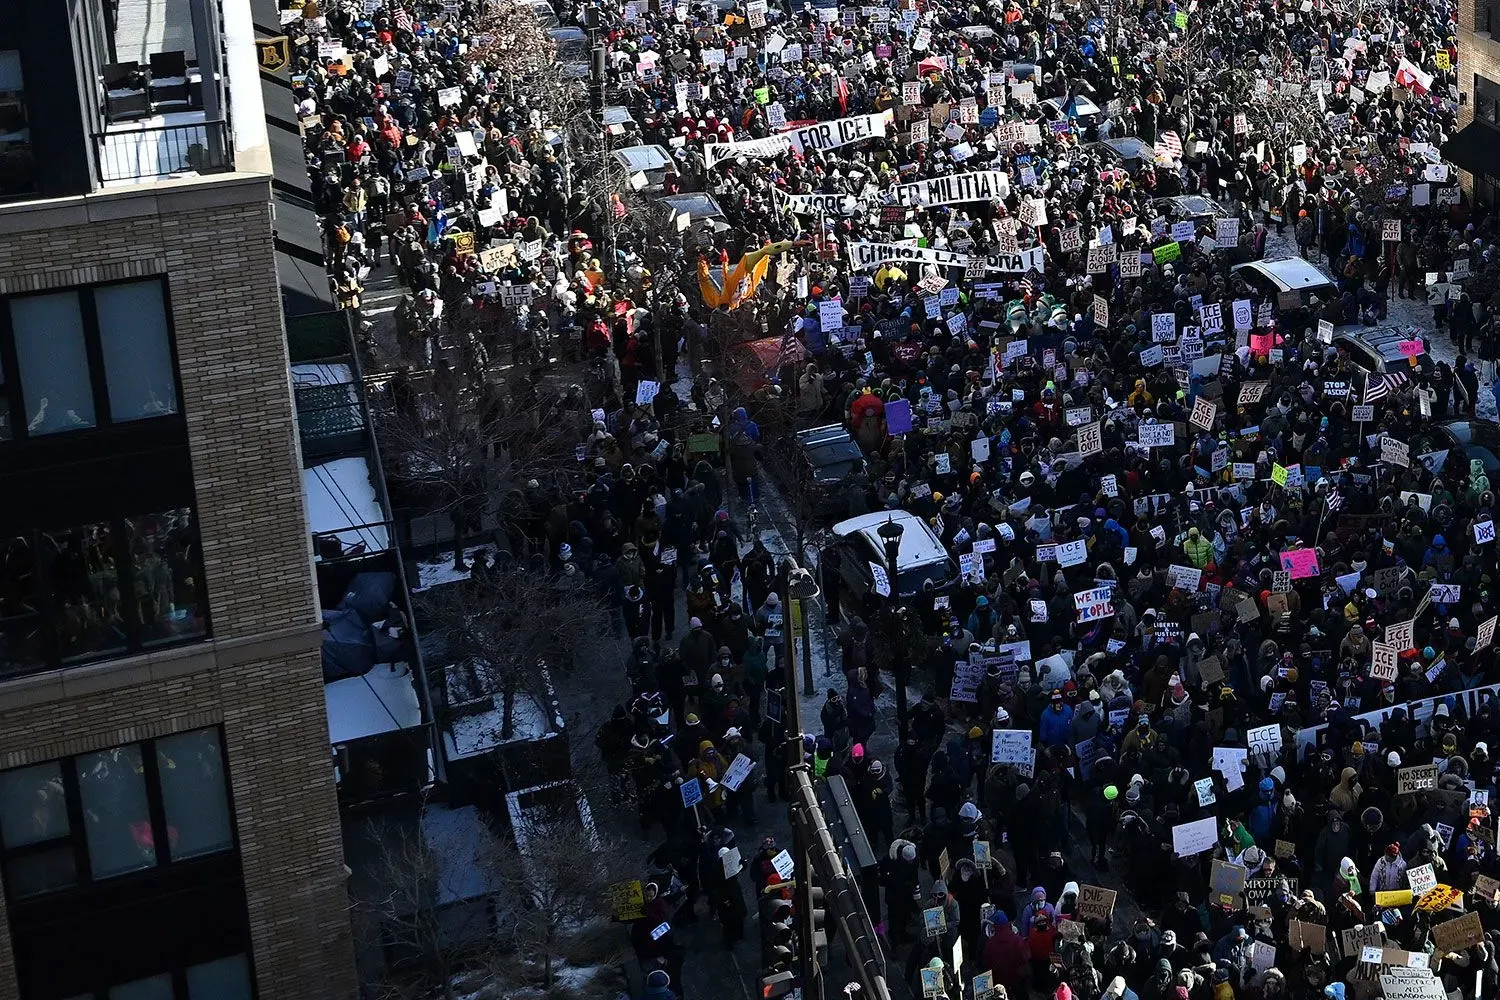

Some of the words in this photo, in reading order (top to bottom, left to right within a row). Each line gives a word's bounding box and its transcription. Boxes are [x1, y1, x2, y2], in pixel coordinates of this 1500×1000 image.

[797, 124, 834, 150] FOR
[837, 116, 873, 143] ICE!
[999, 126, 1013, 134] ICE
[926, 172, 1000, 204] MILITIA!
[1022, 206, 1034, 218] ICE
[996, 220, 1012, 232] ICE
[1383, 223, 1398, 231] ICE
[1001, 237, 1015, 245] ICE
[1062, 231, 1077, 240] ICE
[1383, 231, 1400, 239] OUT!
[1062, 239, 1080, 249] OUT!
[488, 250, 504, 260] ICE
[934, 251, 958, 264] LA
[1123, 257, 1138, 265] ICE
[486, 260, 499, 270] OUT
[1121, 265, 1139, 273] OUT!
[966, 270, 983, 278] OUT!
[506, 285, 529, 296] ICE
[504, 295, 531, 306] OUT
[1095, 301, 1107, 314] ICE
[1201, 304, 1220, 319] ICE
[1095, 311, 1107, 323] OUT!
[1202, 317, 1222, 332] OUT
[1162, 347, 1180, 356] STOP
[1185, 343, 1203, 353] STOP
[1243, 386, 1261, 395] ICE
[1323, 381, 1346, 389] STOP
[1240, 394, 1260, 403] OUT!
[1195, 402, 1212, 416] ICE
[1192, 412, 1210, 427] OUT!
[1080, 429, 1098, 442] ICE
[1080, 439, 1100, 453] OUT!
[1061, 542, 1081, 554] ICE
[1075, 592, 1091, 604] WE
[1092, 588, 1111, 602] THE
[1386, 629, 1406, 640] ICE
[1479, 626, 1492, 640] ICE
[1387, 640, 1406, 651] OUT!
[1375, 651, 1393, 666] ICE
[1373, 664, 1394, 679] OUT!
[1250, 726, 1278, 741] ICE
[1252, 740, 1279, 757] OUT
[1399, 771, 1411, 782] NO
[1411, 768, 1438, 780] SECRET
[1403, 779, 1433, 791] POLICE
[1412, 875, 1431, 885] YOUR
[1083, 888, 1103, 902] DUE
[1416, 886, 1446, 908] LOVE
[1384, 977, 1437, 985] DEMOCRACY
